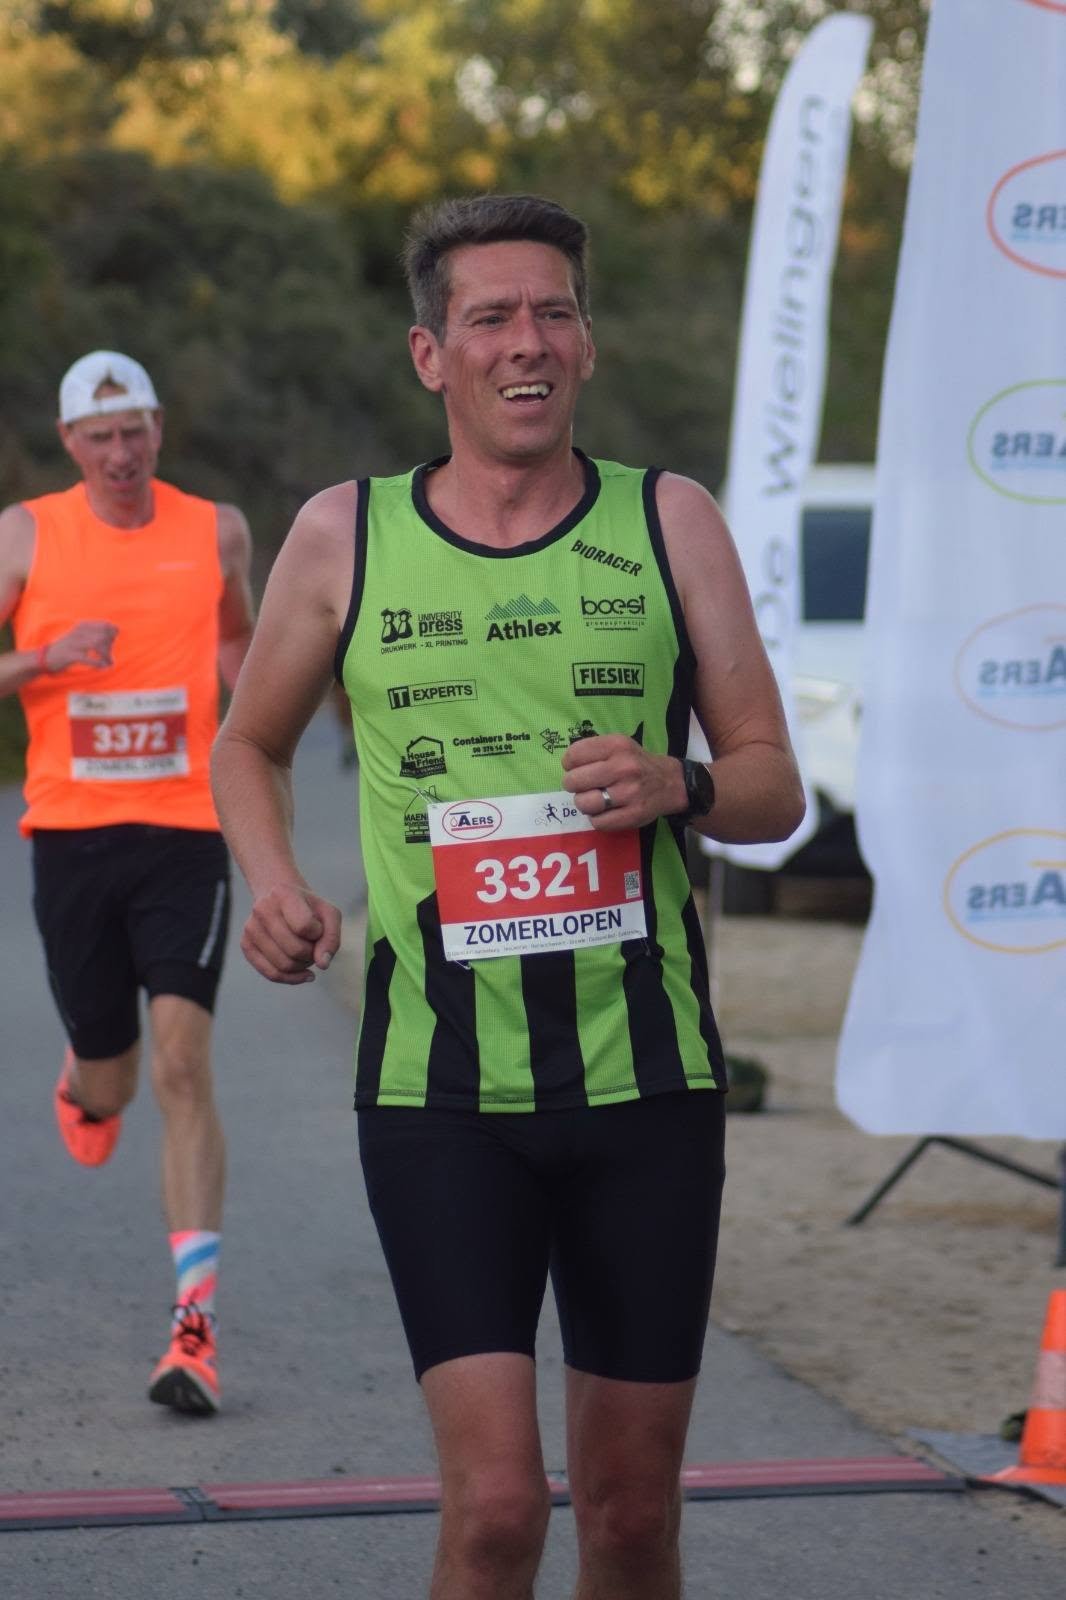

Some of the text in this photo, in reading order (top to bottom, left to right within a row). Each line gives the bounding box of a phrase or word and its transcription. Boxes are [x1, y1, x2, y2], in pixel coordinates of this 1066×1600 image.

[761, 93, 826, 498] Wielingen
[571, 539, 643, 577] BIORACER
[418, 611, 462, 621] UNIVERSITY
[419, 618, 463, 637] press
[486, 619, 562, 642] Athlex
[381, 643, 417, 654] DRUKWERK
[436, 639, 468, 647] PRINTING
[579, 668, 640, 685] FIESIEK
[389, 685, 473, 709] IT EXPERTS
[93, 721, 168, 753] 3372
[453, 734, 503, 746] Containers
[408, 751, 435, 761] House
[404, 813, 428, 821] MAEN
[458, 814, 494, 827] AERS
[563, 807, 577, 818] De
[475, 849, 599, 904] 3321
[464, 908, 623, 945] ZOMERLOPEN
